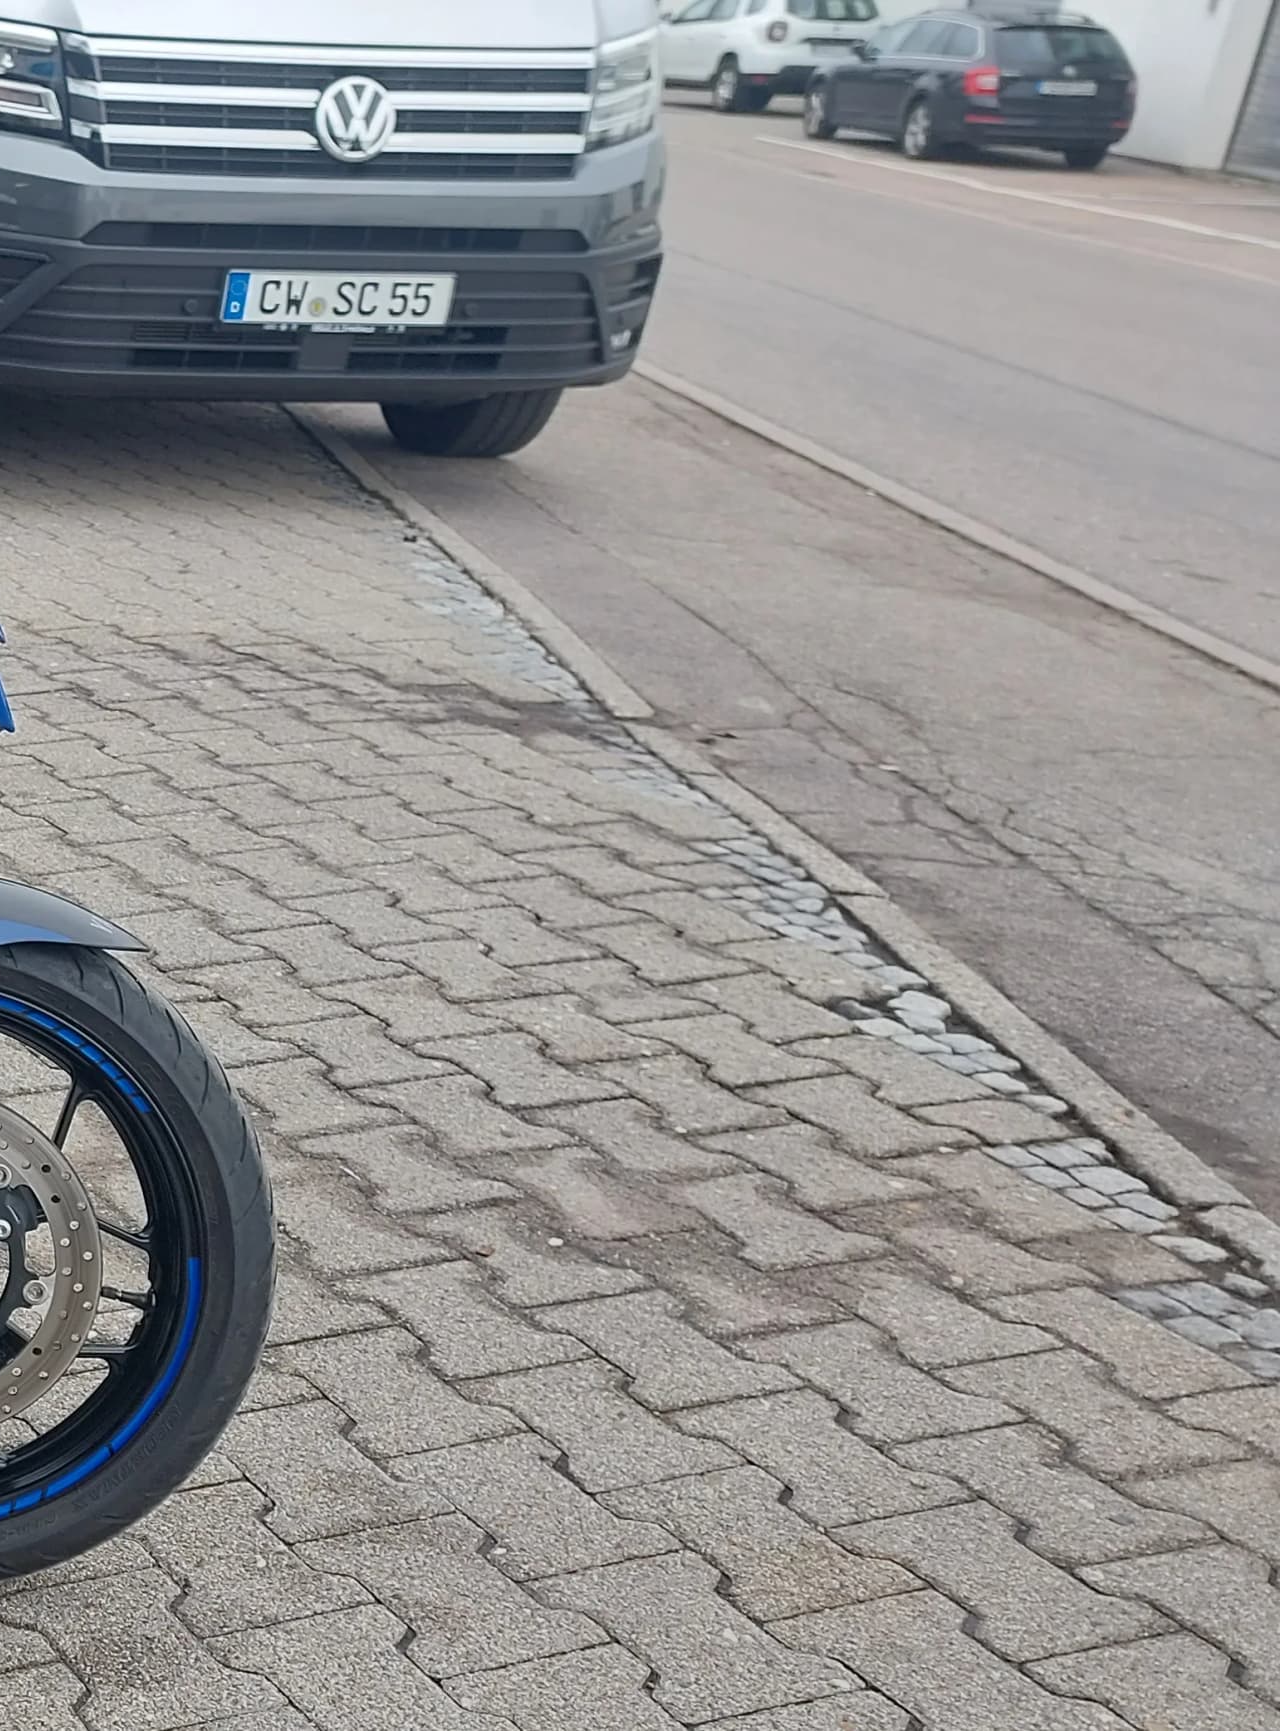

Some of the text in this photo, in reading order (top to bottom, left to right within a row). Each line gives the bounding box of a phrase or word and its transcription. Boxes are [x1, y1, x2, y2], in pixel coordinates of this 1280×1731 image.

[319, 78, 394, 159] VW
[259, 280, 308, 316] CW
[333, 281, 379, 316] SC
[388, 282, 435, 317] 55
